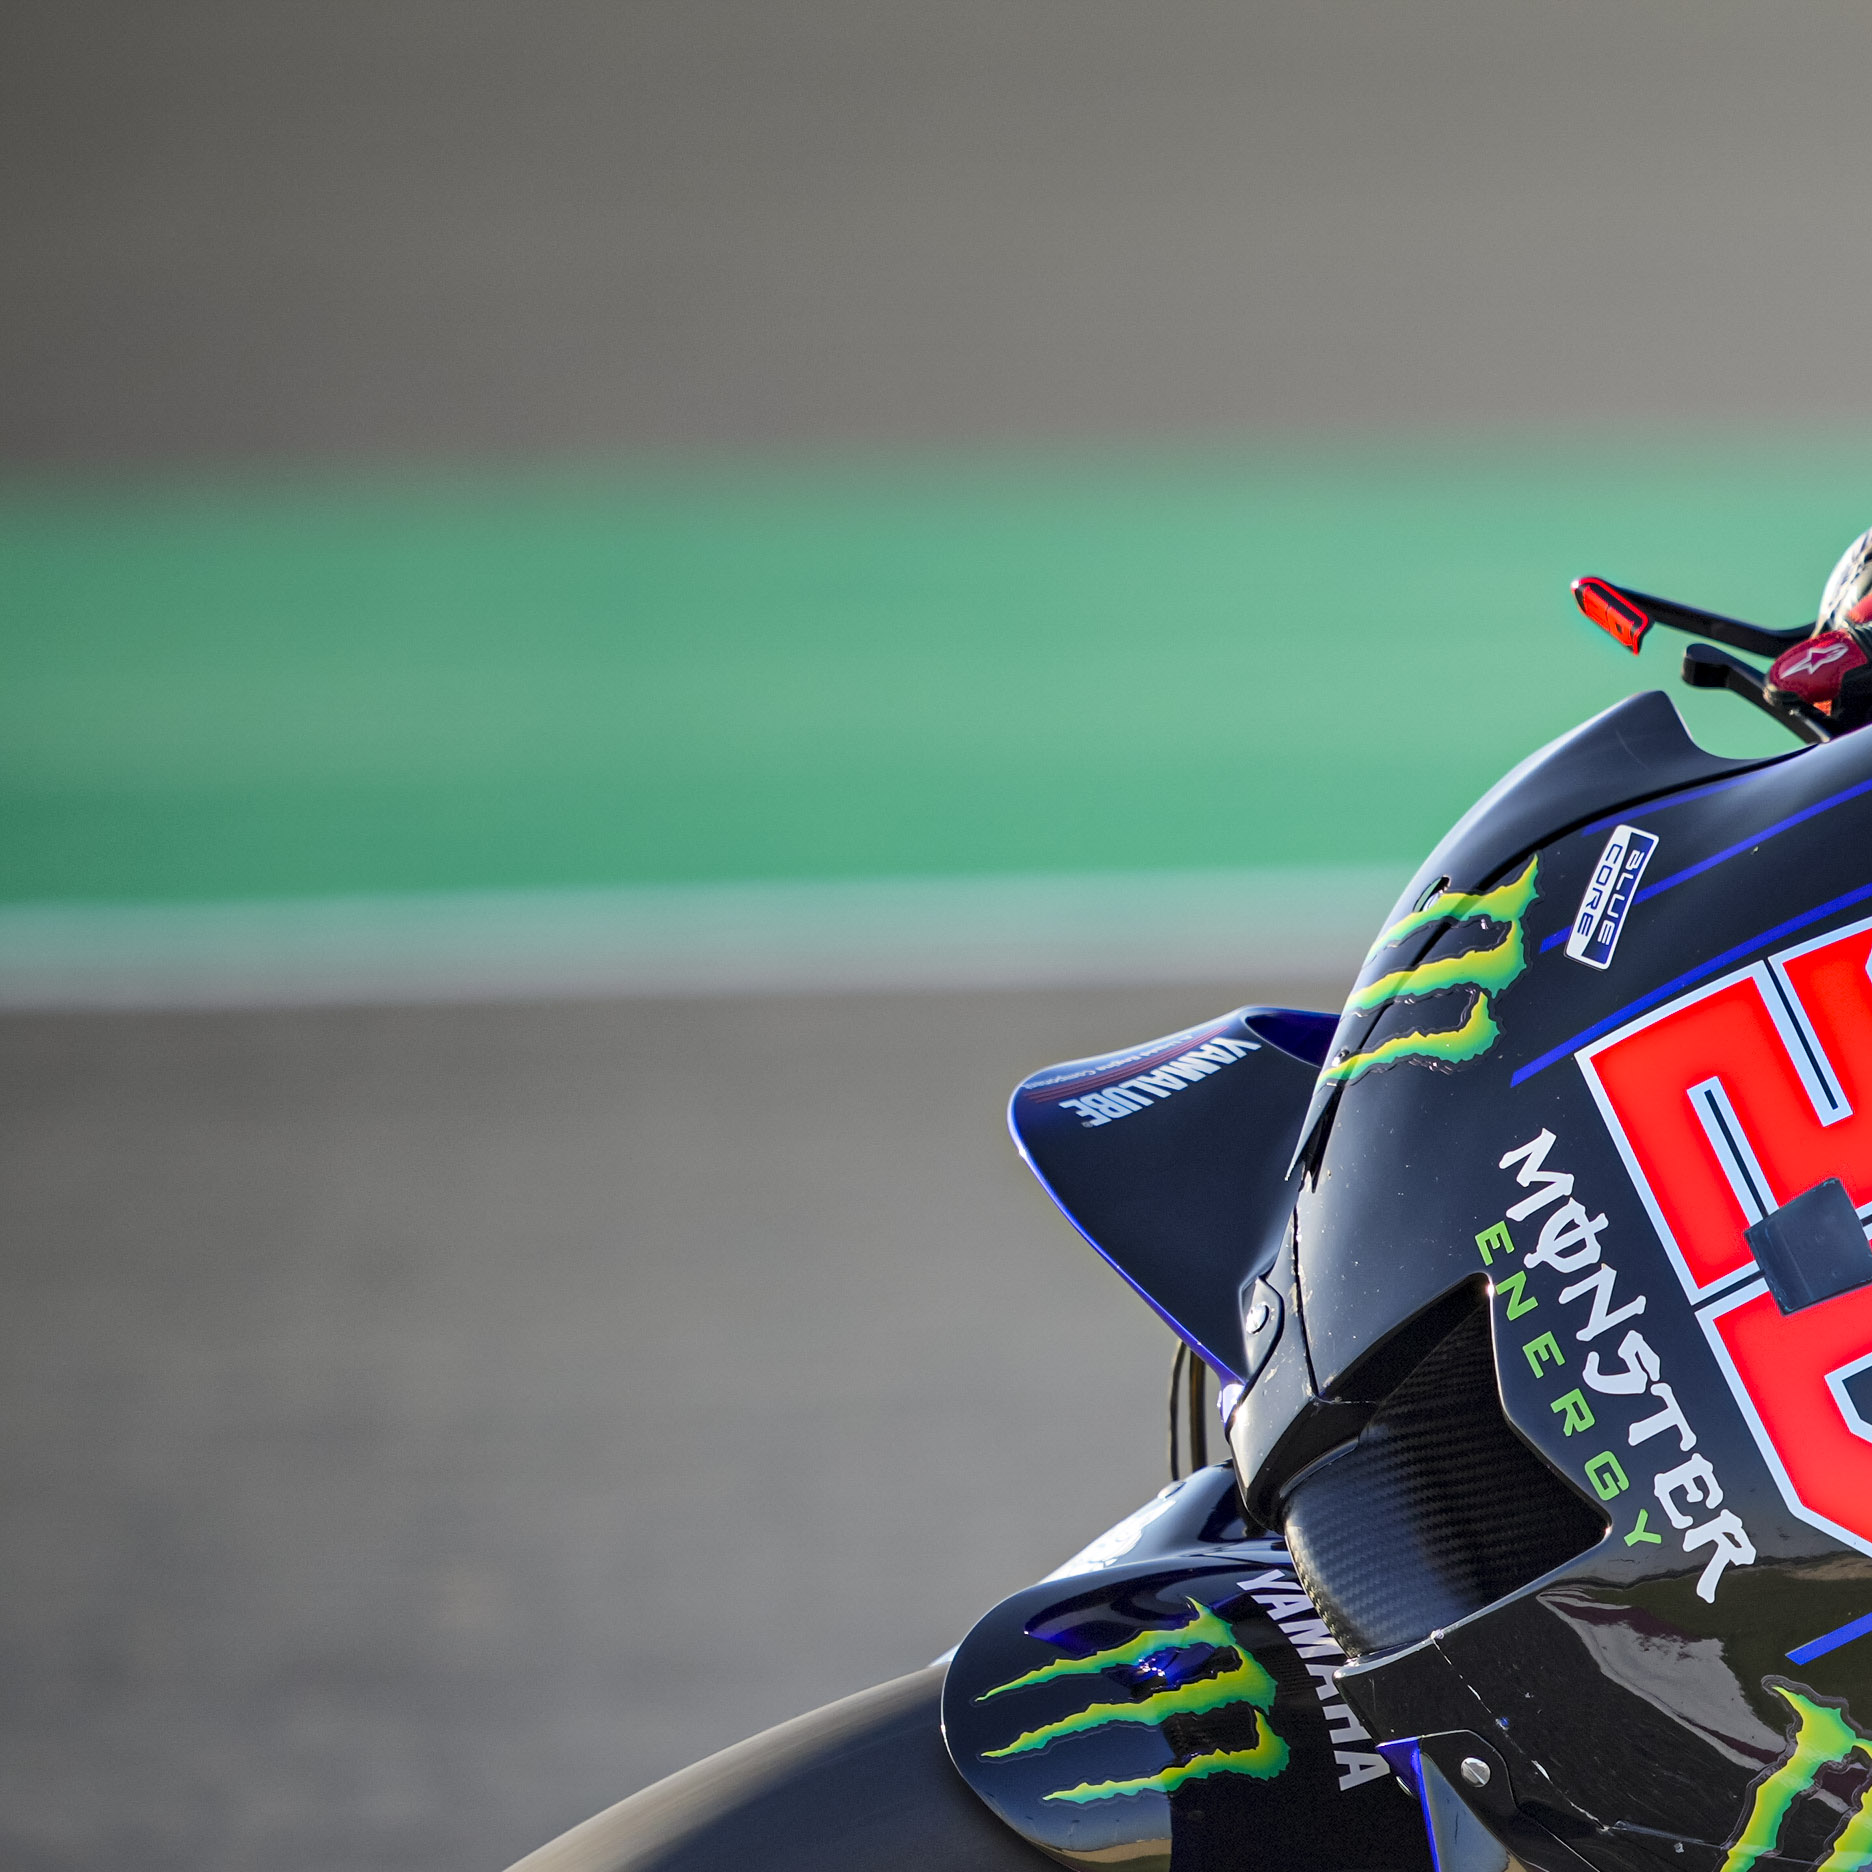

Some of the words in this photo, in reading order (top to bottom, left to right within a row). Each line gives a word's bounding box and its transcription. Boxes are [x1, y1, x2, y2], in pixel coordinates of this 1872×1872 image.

[1577, 844, 1623, 937] CORE
[1598, 850, 1645, 945] BLUE
[1059, 1038, 1261, 1127] YAMALUBE
[1474, 1220, 1662, 1547] ENERGY
